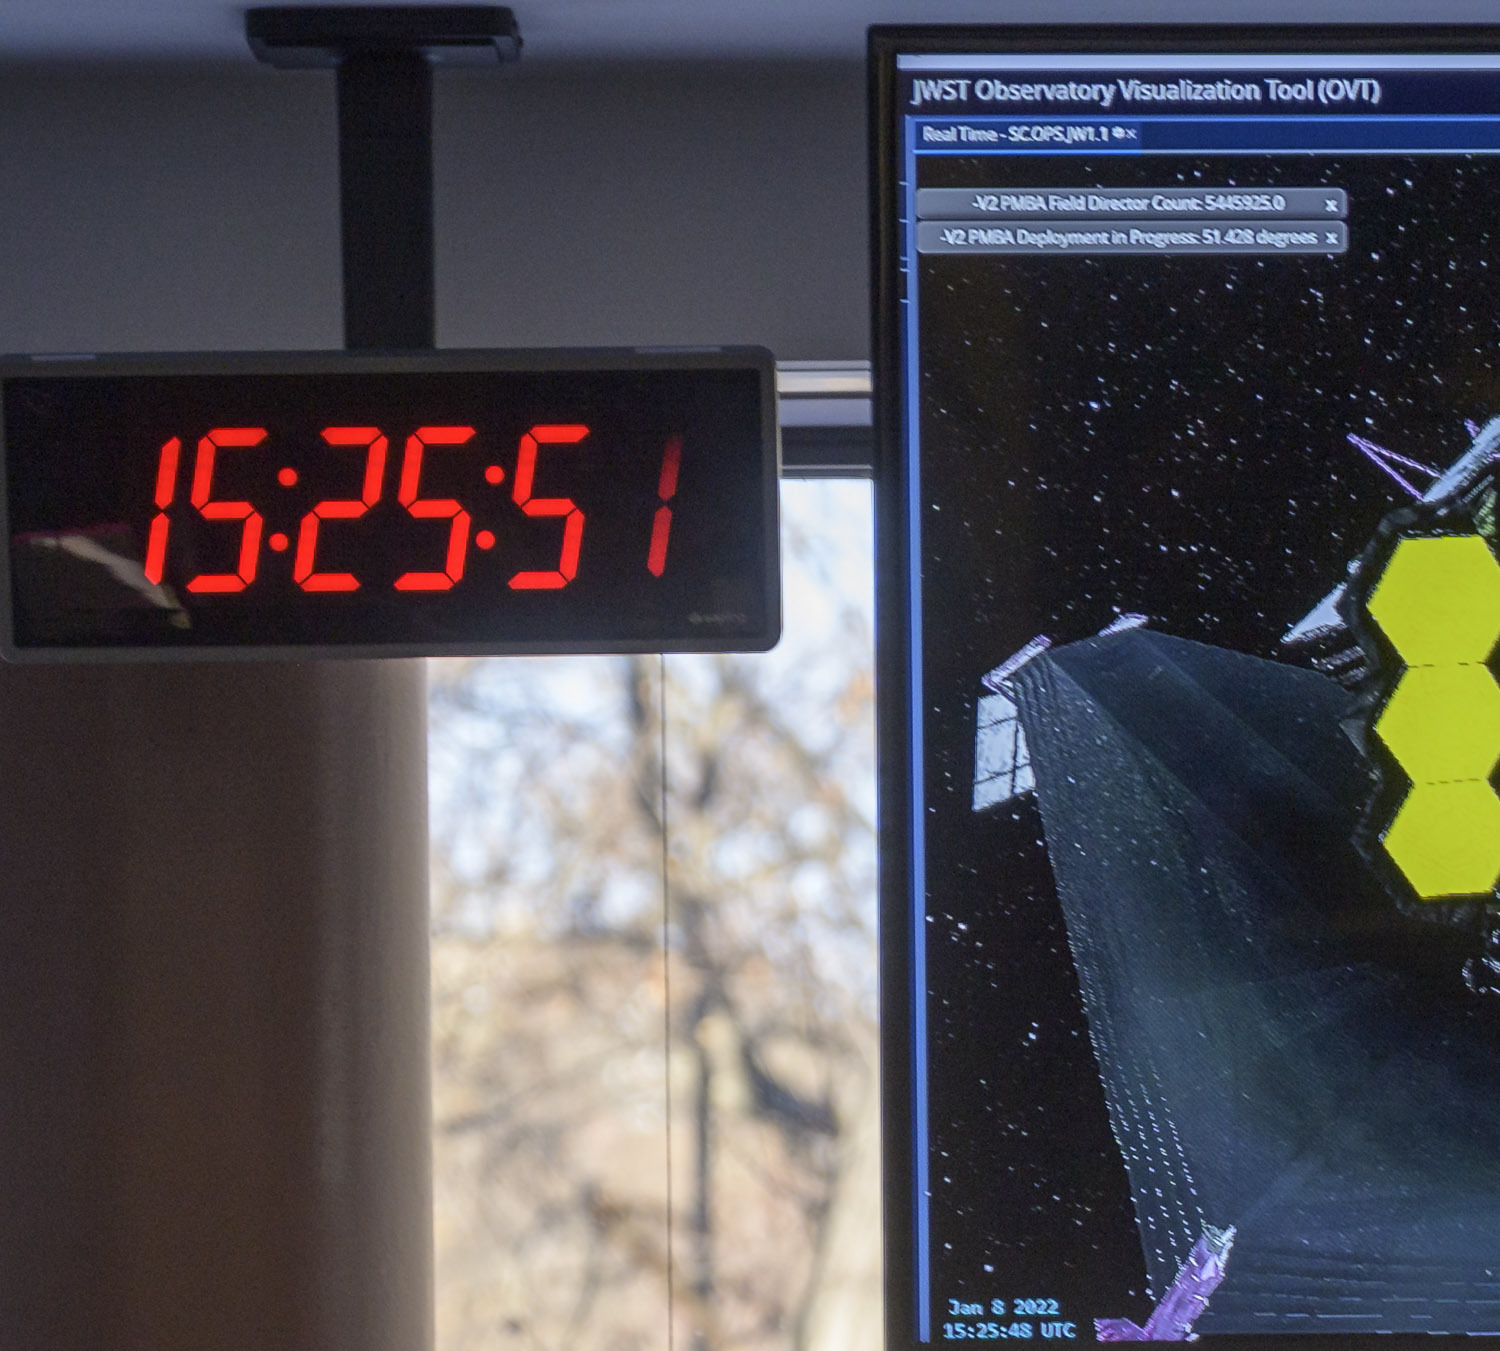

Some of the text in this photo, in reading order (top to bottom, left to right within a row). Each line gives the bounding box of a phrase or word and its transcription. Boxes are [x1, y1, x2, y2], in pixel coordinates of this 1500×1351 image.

[910, 78, 1381, 107] JWST Observatory Visualization Tool (OVT)
[922, 125, 957, 143] Real
[958, 125, 999, 143] Time
[1016, 228, 1110, 248] Deployment
[1110, 228, 1128, 245] in
[1255, 228, 1319, 248] degrees
[144, 424, 682, 593] 15:25:51
[948, 1298, 984, 1316] Jan
[1013, 1298, 1060, 1316] 2022
[943, 1321, 1077, 1340] 15:25:48 UTC
